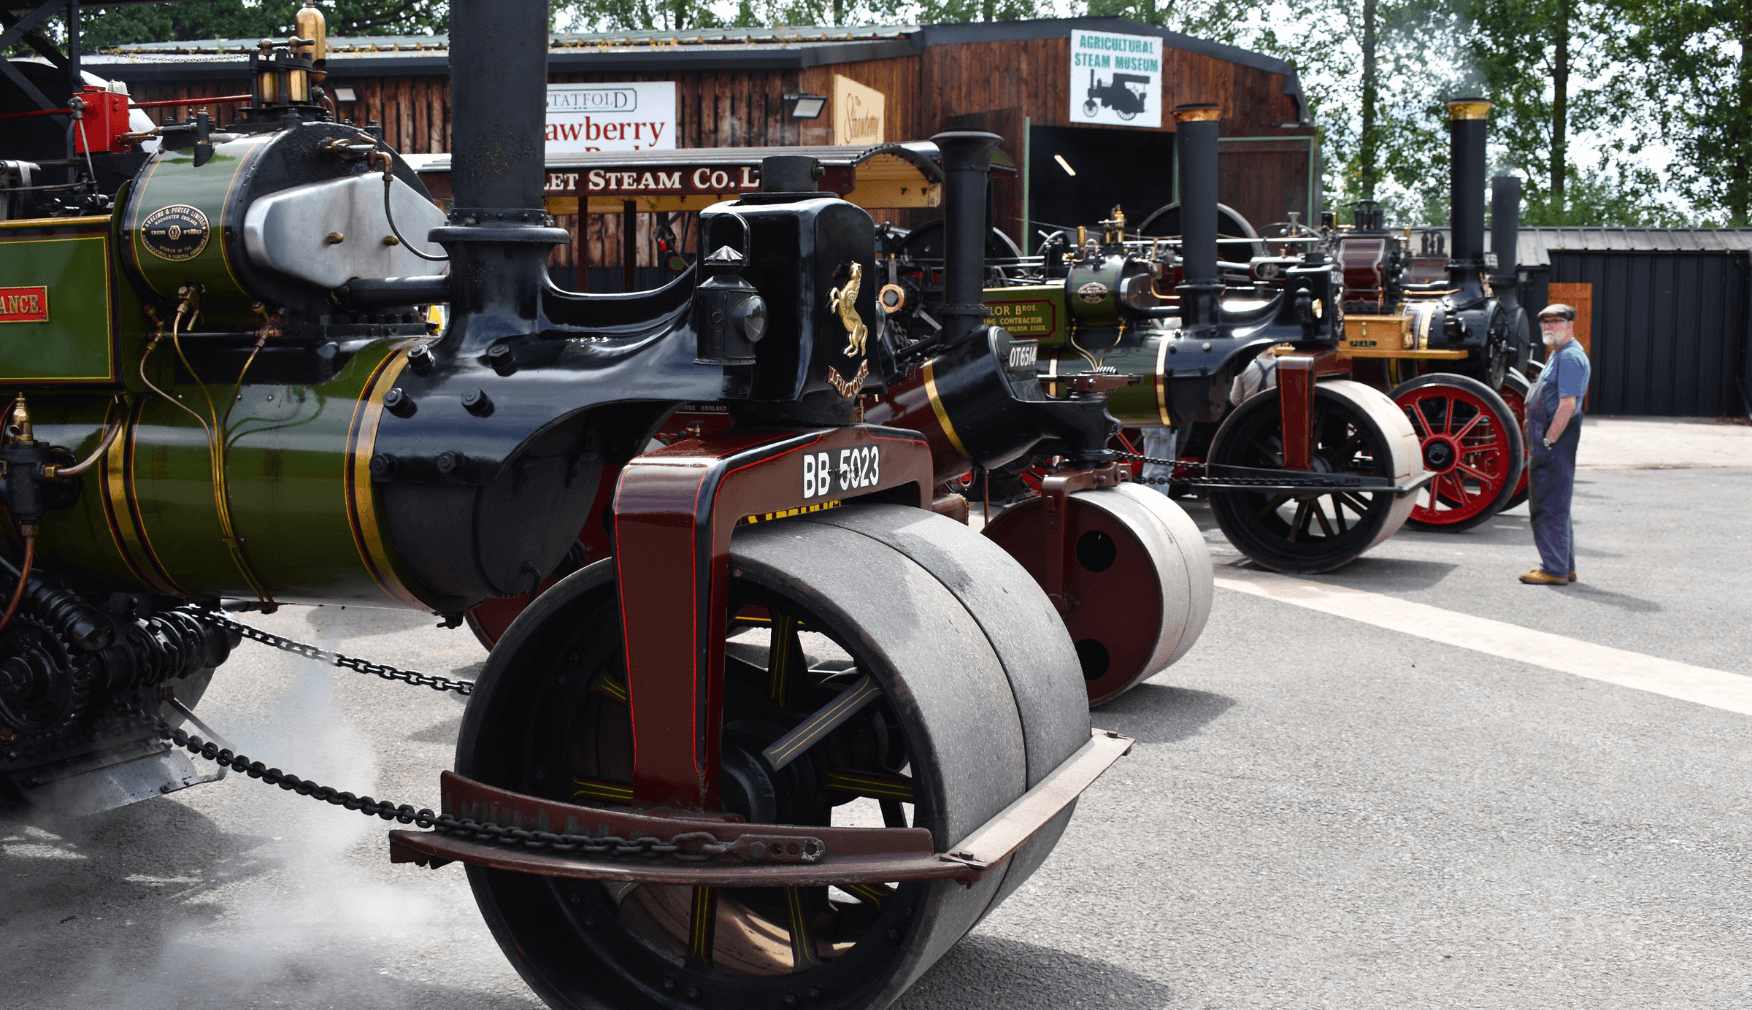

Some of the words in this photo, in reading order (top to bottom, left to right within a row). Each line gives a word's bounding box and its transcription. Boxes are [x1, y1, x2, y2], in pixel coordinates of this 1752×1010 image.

[1080, 35, 1154, 54] AGRICULTURAL
[1074, 52, 1111, 68] STEAM
[1115, 56, 1159, 73] MUSEUM
[546, 91, 628, 109] TATFOLD
[588, 169, 682, 190] STEAM
[145, 211, 164, 228] AVELING
[1000, 317, 1042, 325] CONTRACTOR
[803, 452, 831, 499] BB
[839, 446, 879, 491] 5023
